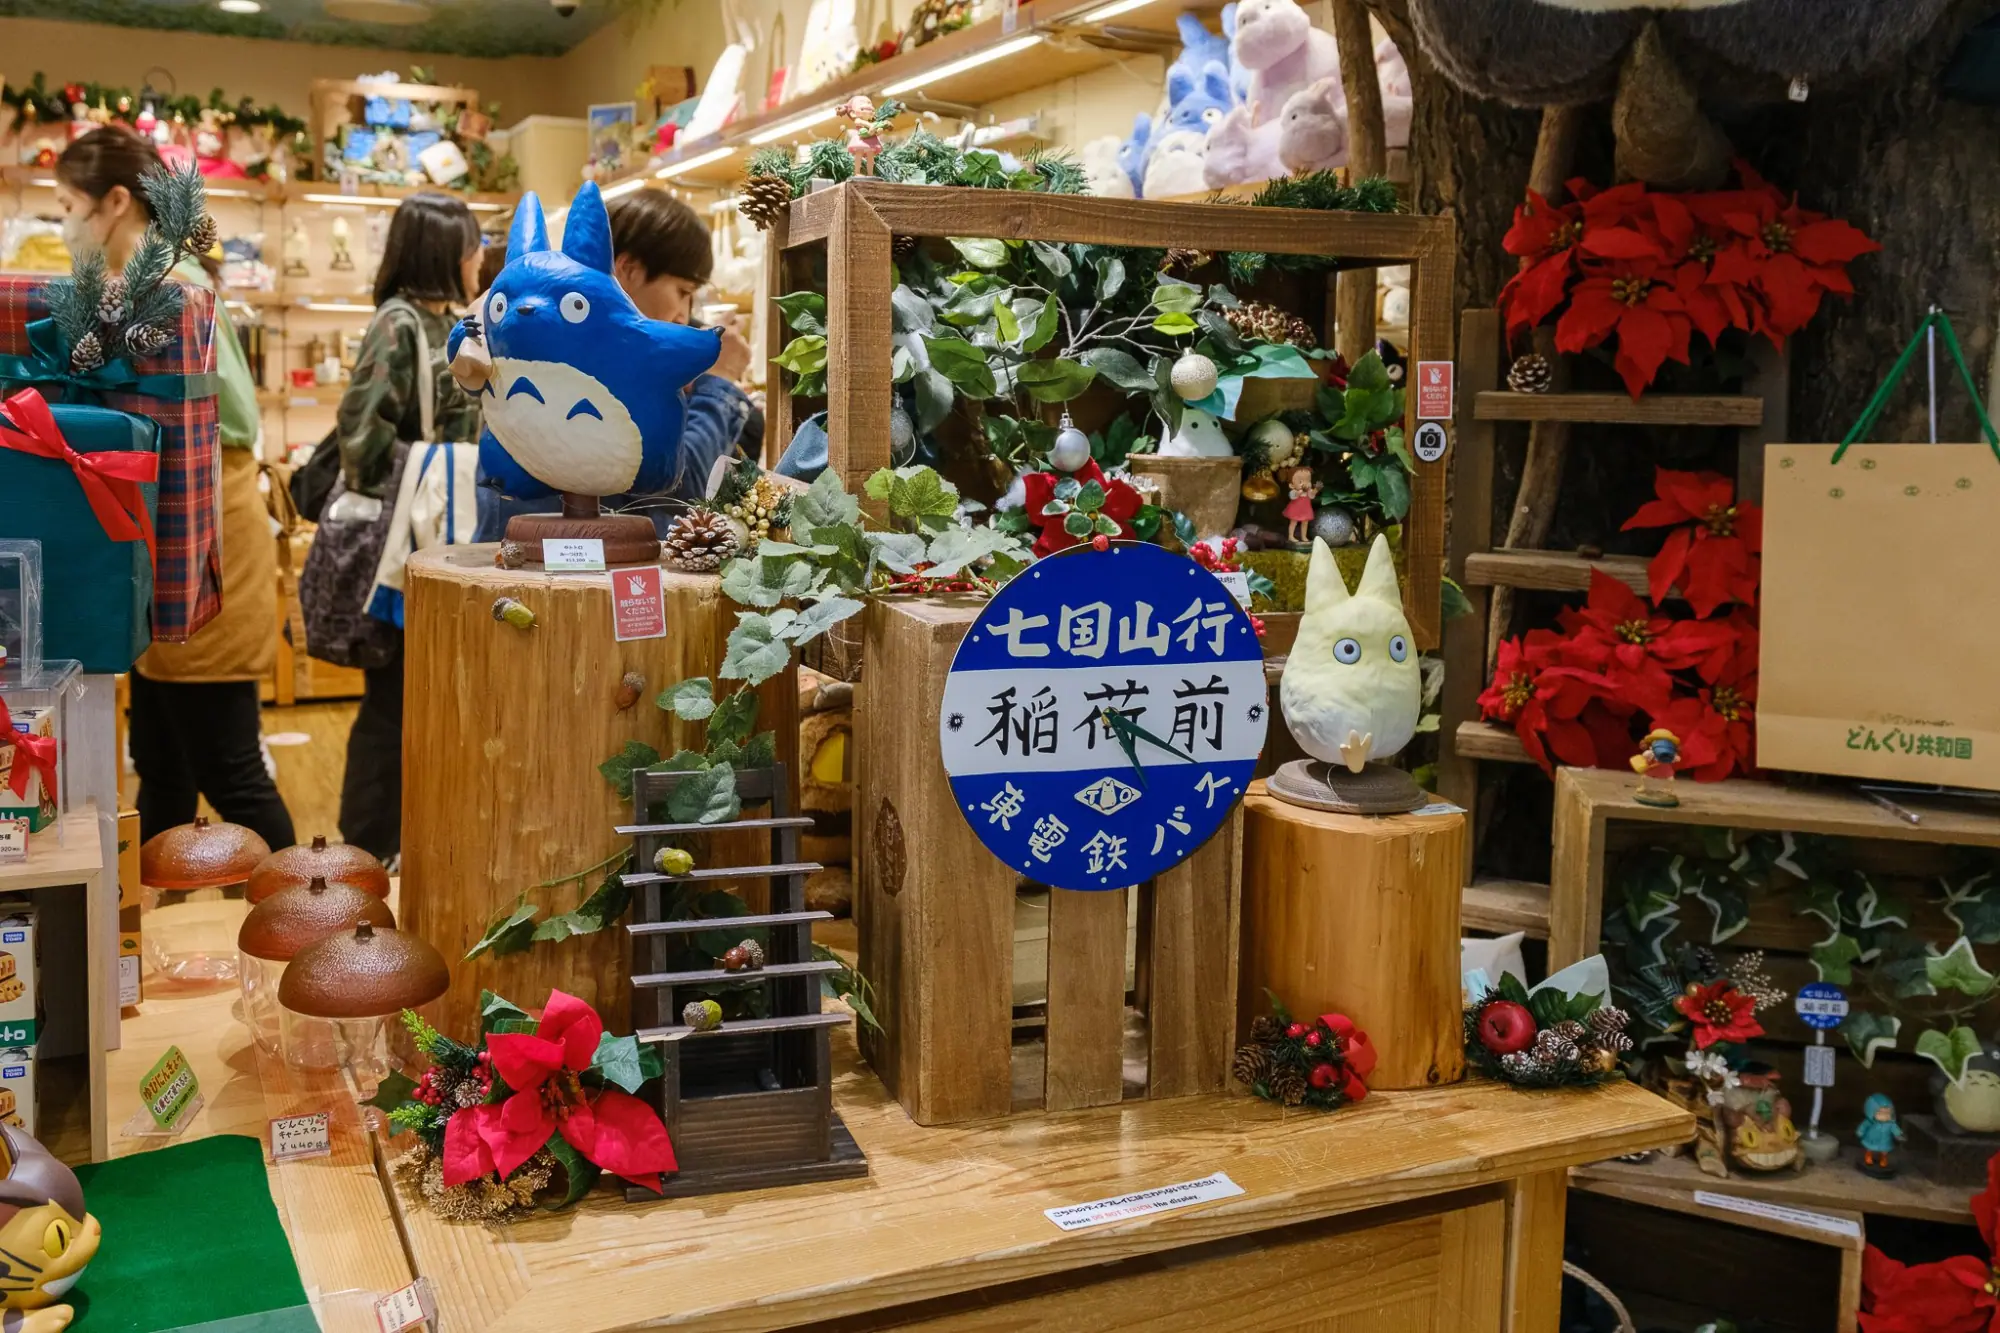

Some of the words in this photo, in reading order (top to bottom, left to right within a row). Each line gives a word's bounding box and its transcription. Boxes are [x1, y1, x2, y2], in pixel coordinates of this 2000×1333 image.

[1423, 449, 1437, 457] OK!
[985, 597, 1234, 660] 七国山行
[974, 674, 1230, 757] 稲荷前
[1846, 724, 1973, 760] どんぐり共和国
[0, 1025, 26, 1042] トロ
[142, 1051, 184, 1101] ゆびにんぎょう
[277, 1117, 315, 1130] どんぐり
[279, 1126, 325, 1139] キャニスター
[1063, 1217, 1090, 1227] Please
[1091, 1213, 1104, 1221] DO
[1105, 1210, 1122, 1219] NOT
[1125, 1204, 1153, 1214] TOUCH
